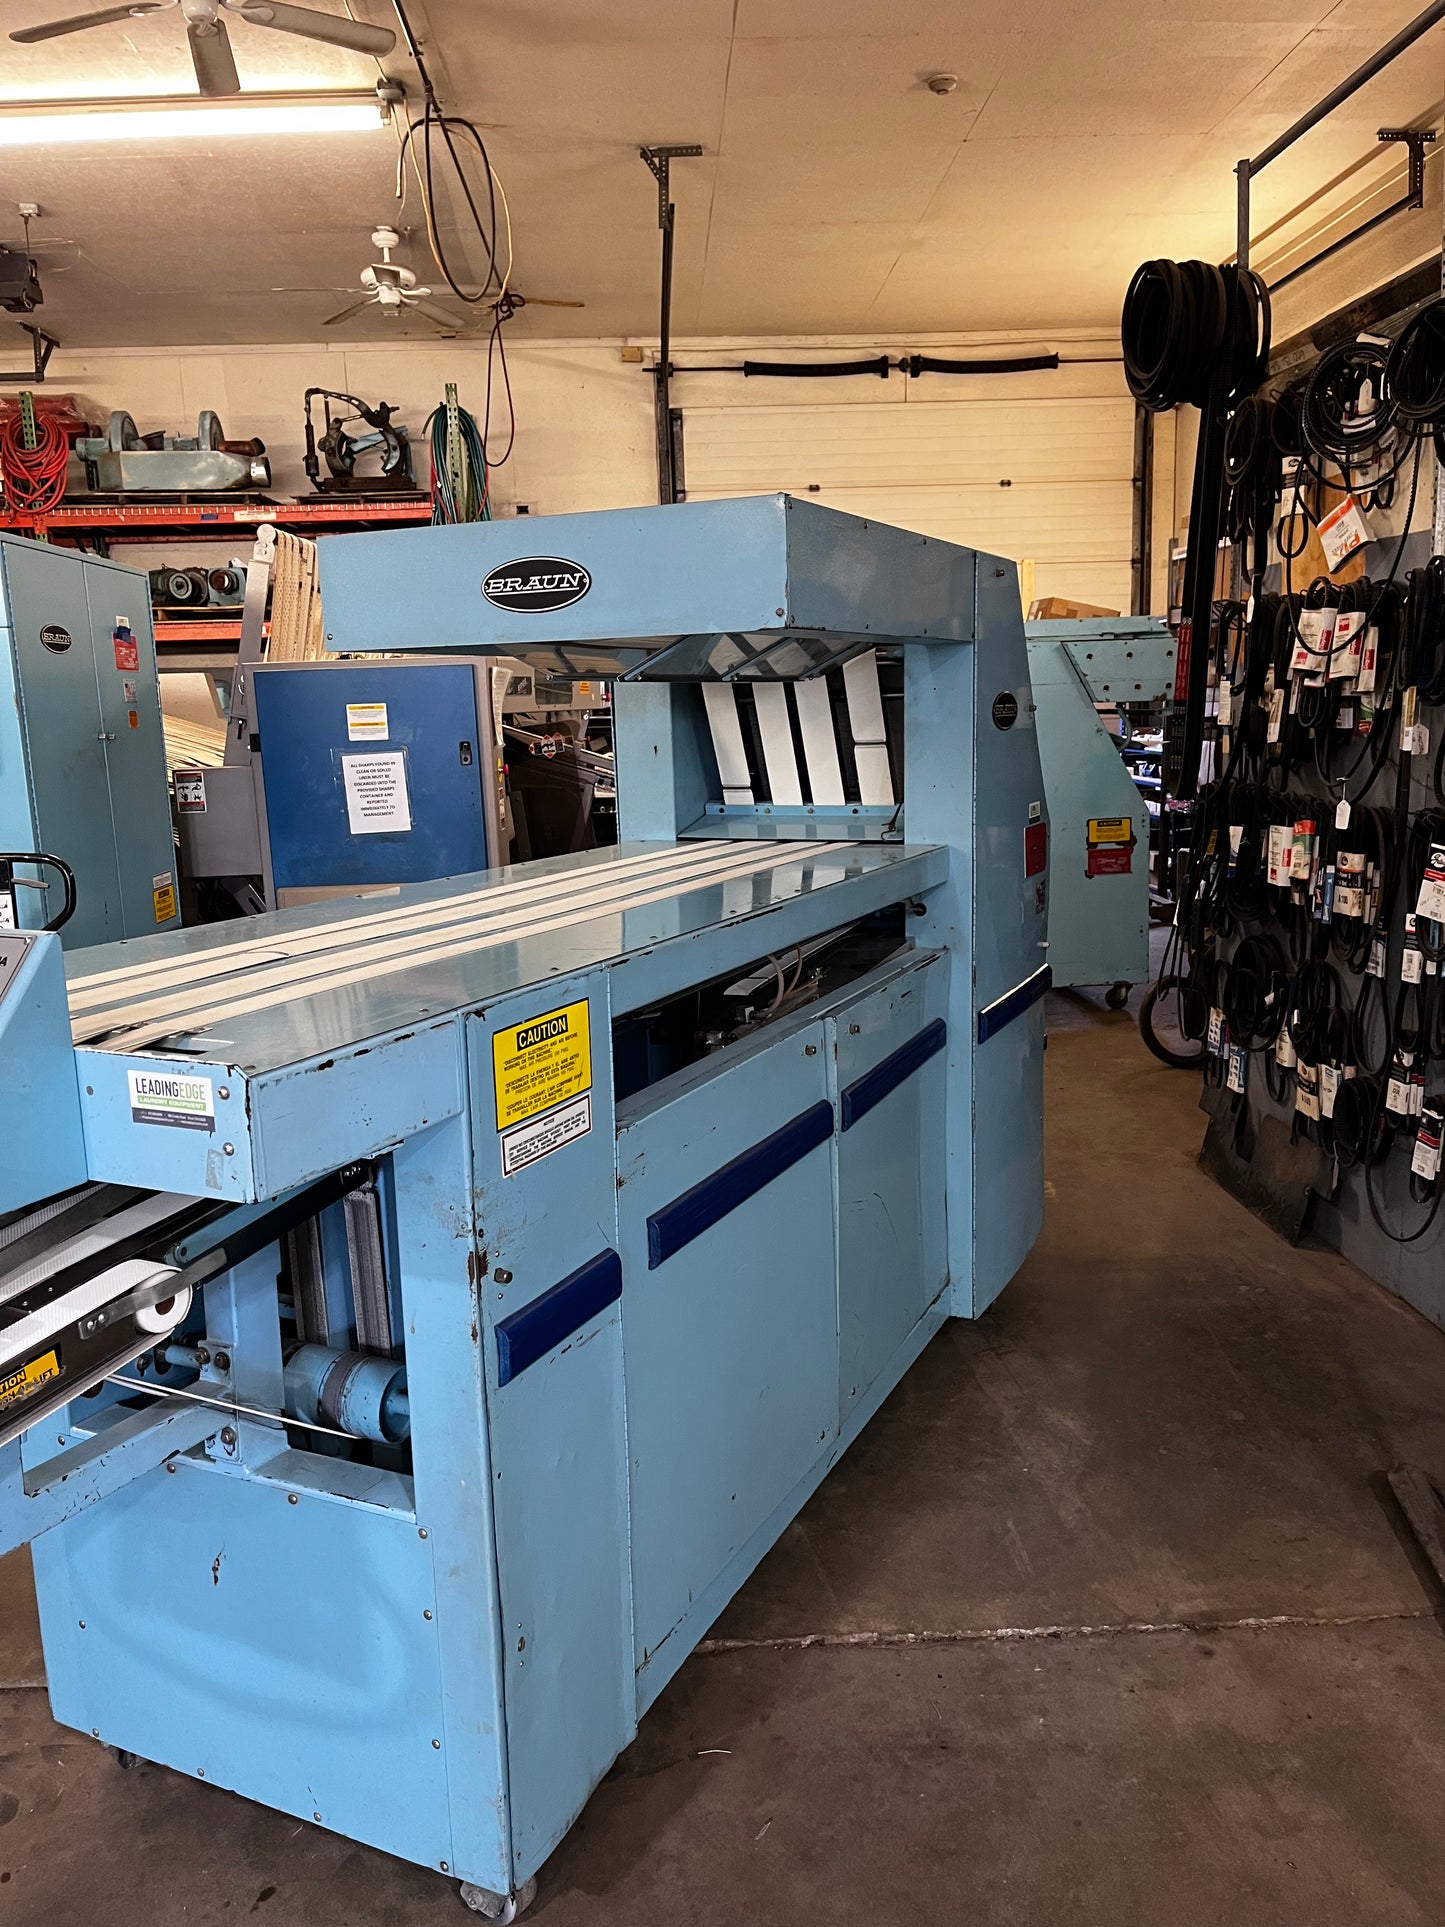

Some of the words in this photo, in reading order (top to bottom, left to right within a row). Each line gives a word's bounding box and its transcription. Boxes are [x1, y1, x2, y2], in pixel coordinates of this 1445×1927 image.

[486, 572, 584, 593] BRAUN
[44, 632, 70, 643] BRAUN
[519, 1017, 567, 1049] CAUTION
[135, 1078, 206, 1100] LEADINGEDGE
[140, 1096, 168, 1106] LAUNDRY
[169, 1098, 205, 1109] EQUIPMENT
